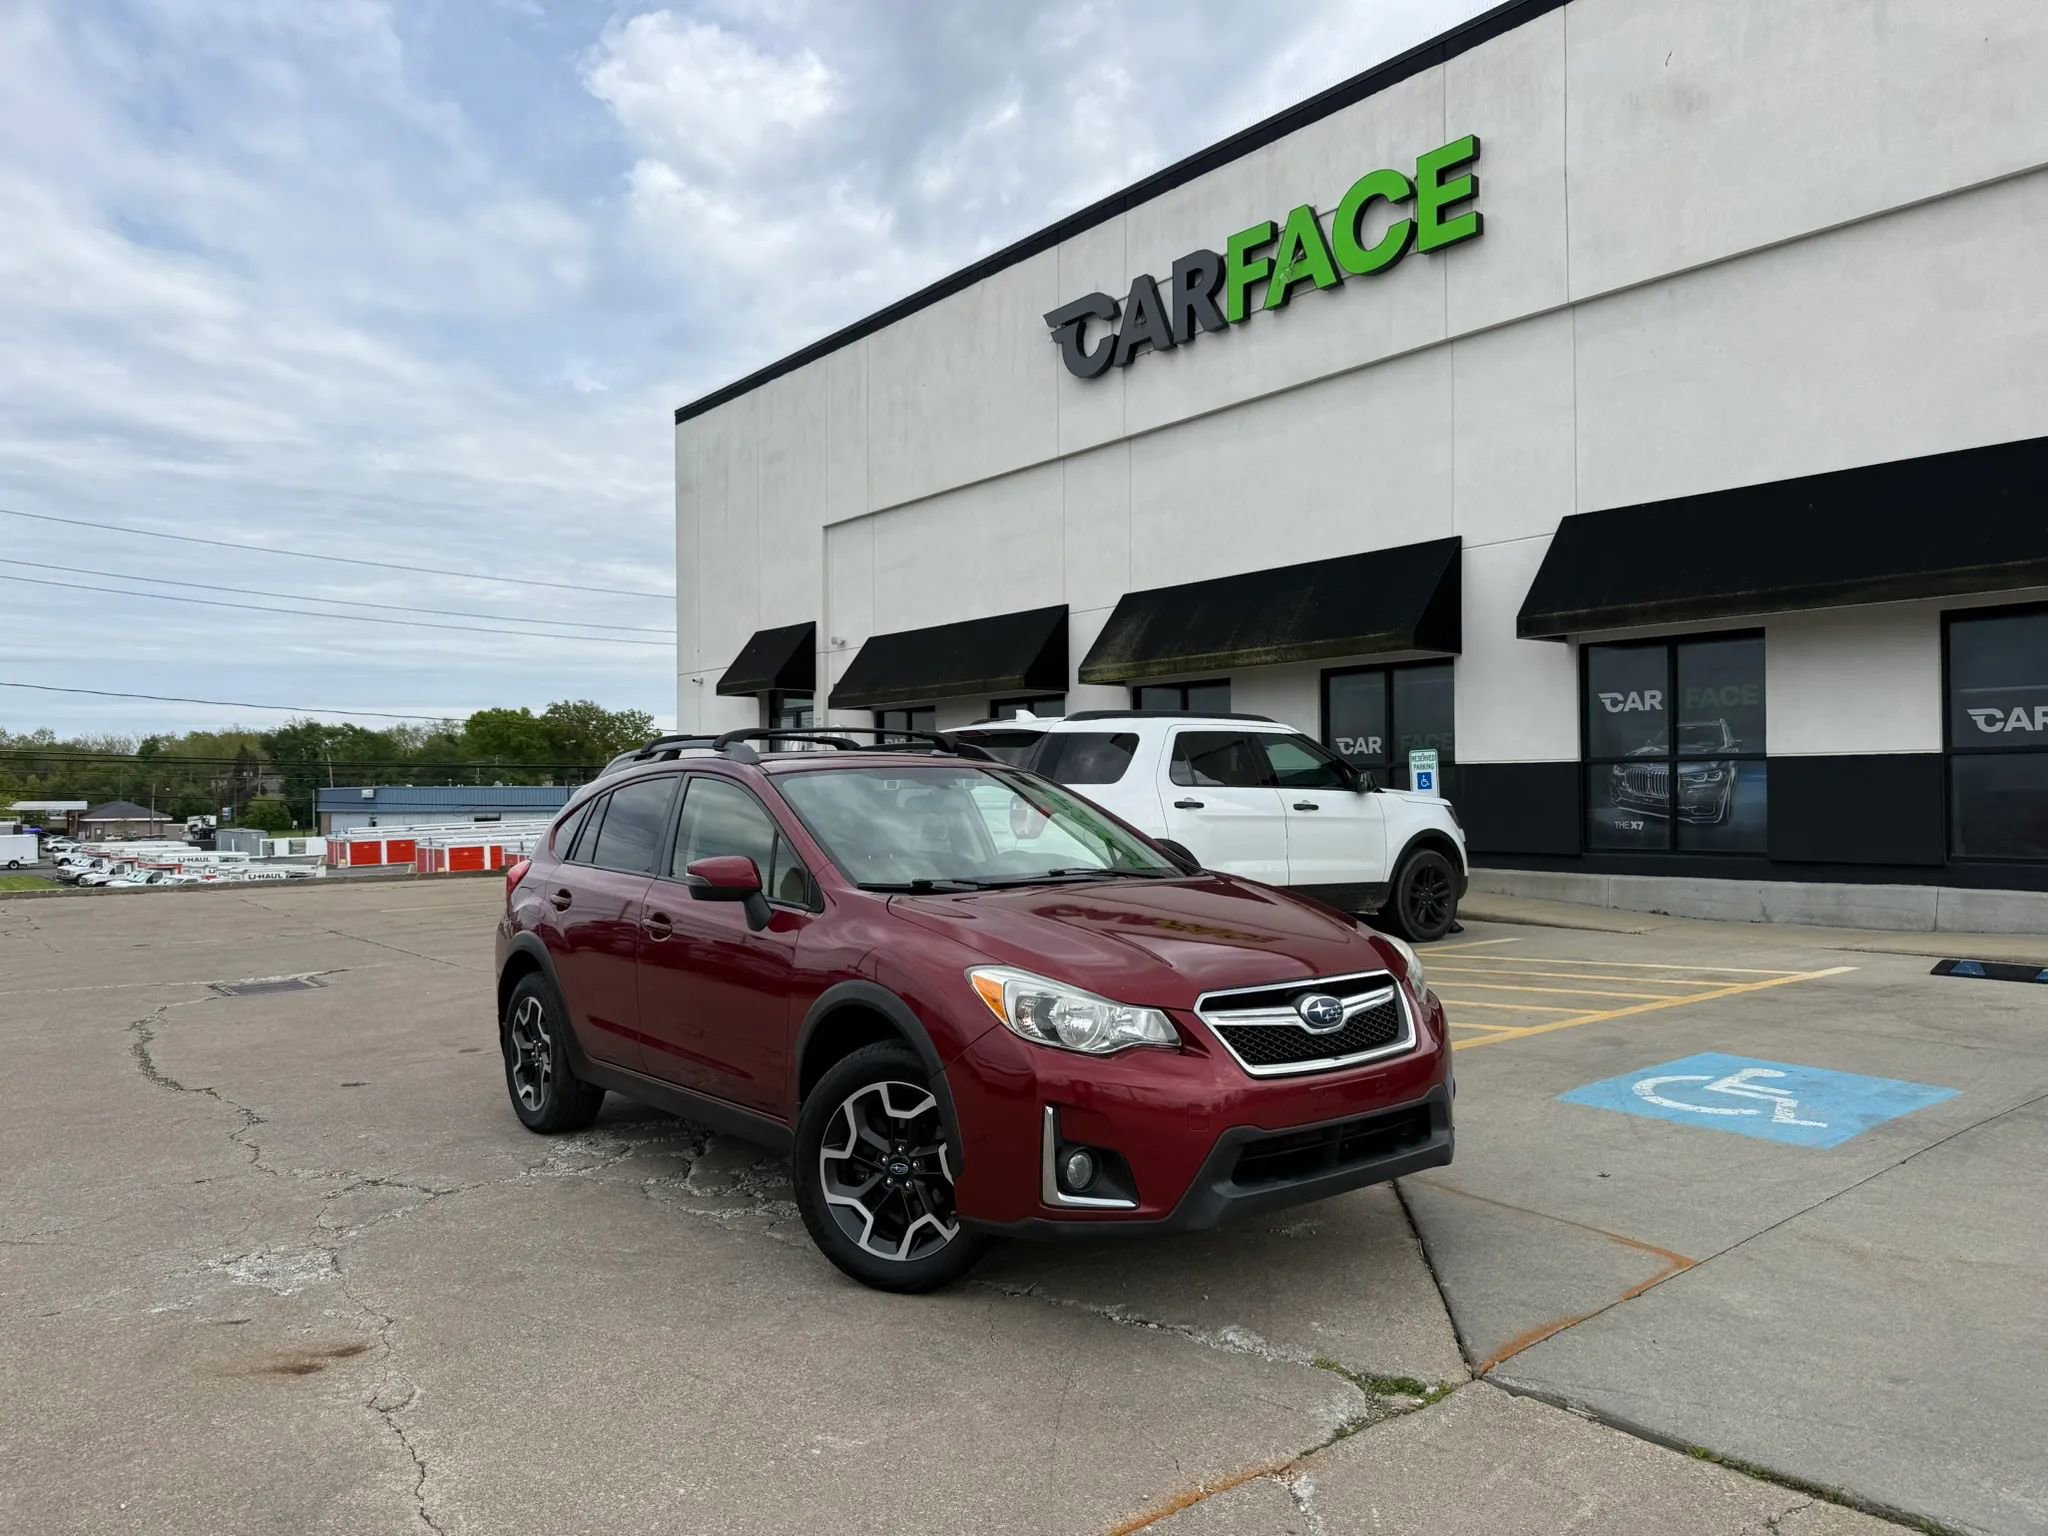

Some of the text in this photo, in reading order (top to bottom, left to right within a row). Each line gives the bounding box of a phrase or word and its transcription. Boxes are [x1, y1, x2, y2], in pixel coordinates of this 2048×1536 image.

[1597, 684, 1759, 713] CAR FACE
[1336, 736, 1383, 755] CAR
[1411, 754, 1435, 762] RESERVED
[1614, 820, 1645, 830] THE X7
